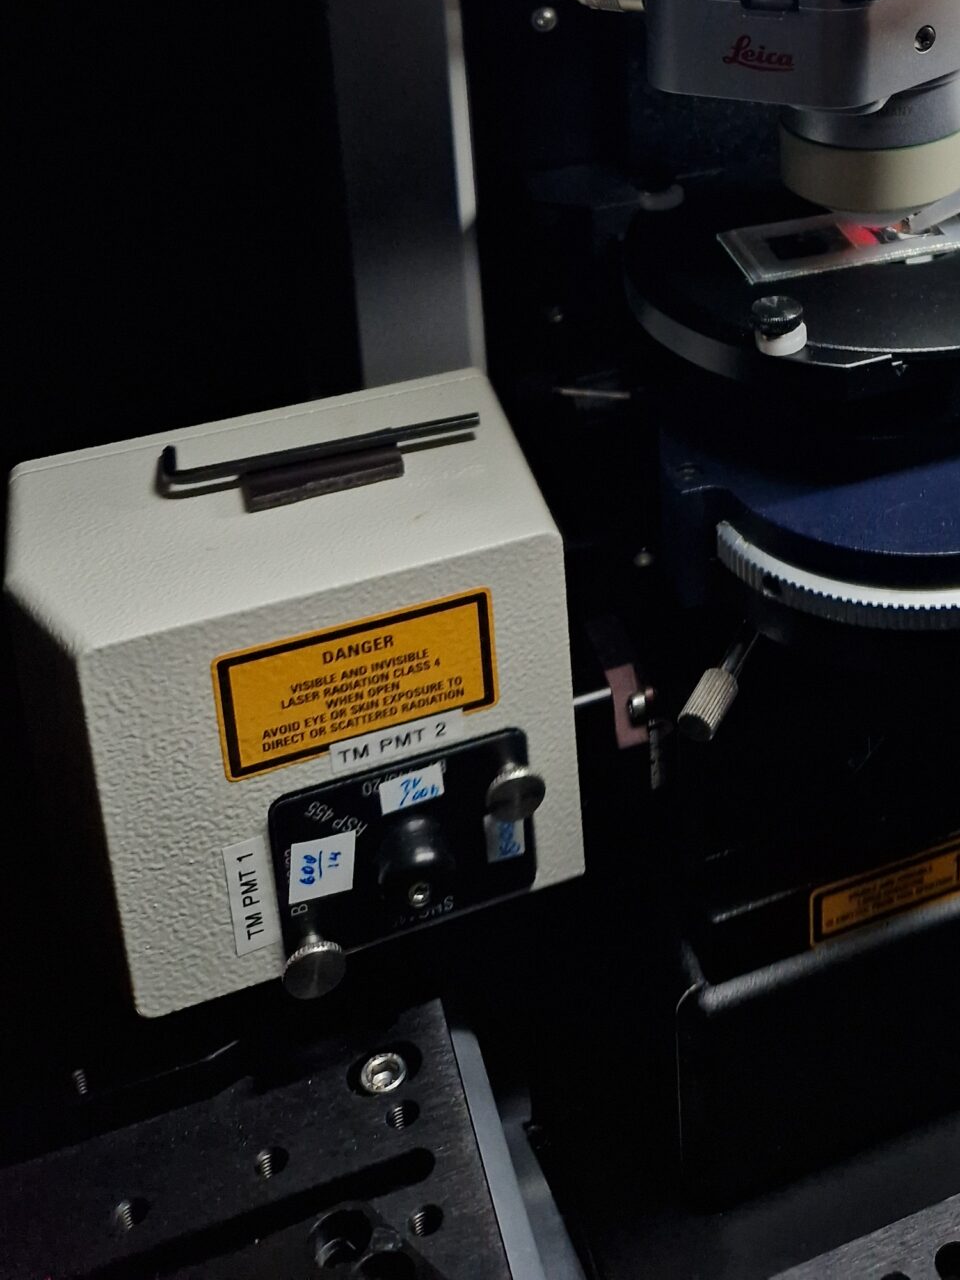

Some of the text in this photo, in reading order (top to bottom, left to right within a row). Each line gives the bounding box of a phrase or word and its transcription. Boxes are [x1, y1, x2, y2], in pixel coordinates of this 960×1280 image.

[722, 34, 795, 72] Leica
[290, 648, 429, 694] VISIBLE AND INVISIBLE
[322, 634, 394, 665] DANGER
[281, 657, 440, 710] LASER RADIATION CLASS 4
[325, 681, 400, 710] WHEN OPEN
[262, 675, 463, 741] AVOID EYE OR SKIN EXPOSURE TO
[262, 687, 465, 752] DIRECT OR SCATTERED RADIATION
[338, 721, 447, 764] TM PMT 2
[236, 852, 265, 940] TM PMT 1
